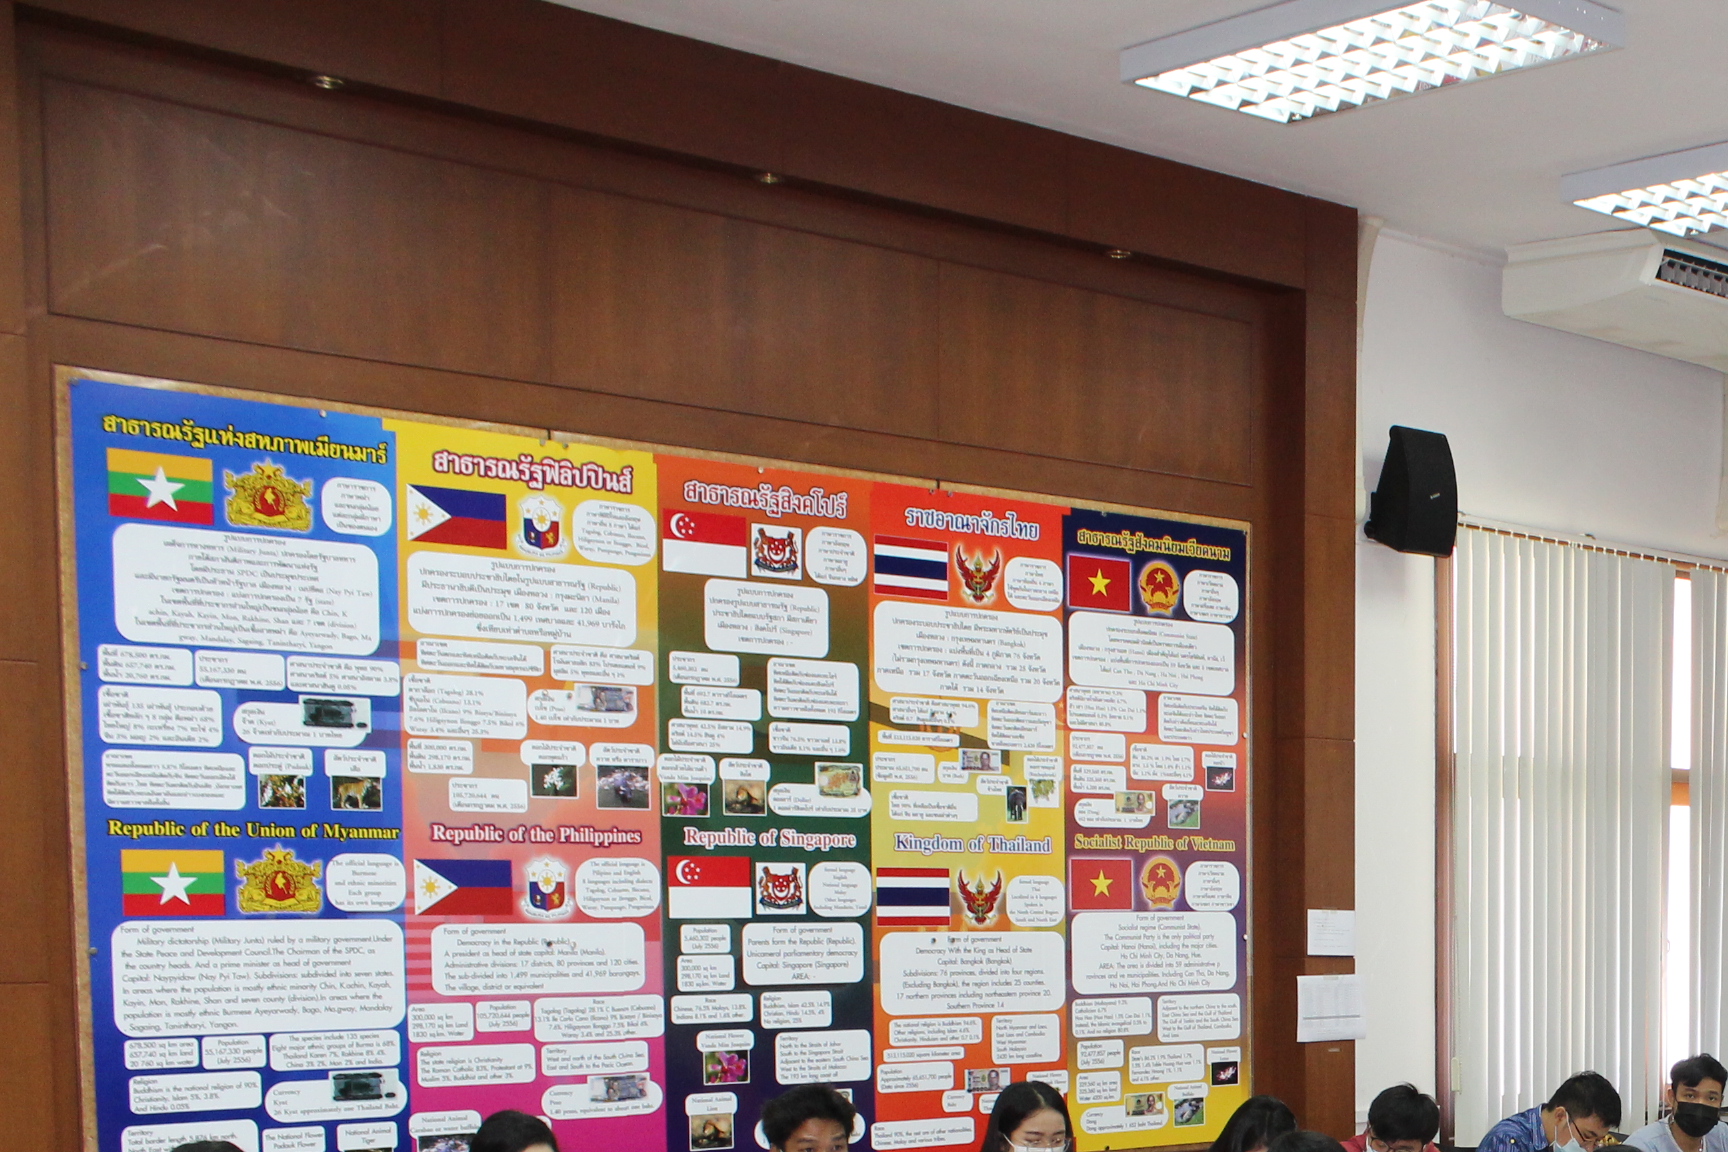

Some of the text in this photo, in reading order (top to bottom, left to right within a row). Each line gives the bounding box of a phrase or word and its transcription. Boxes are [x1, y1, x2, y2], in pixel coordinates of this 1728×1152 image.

[103, 412, 388, 466] สาธารณรัฐแห่งสหภาพเมียนมาร์
[433, 450, 634, 495] สาธารณรัฐฟิลิปปินส์
[683, 479, 848, 519] สาธารณรัฐสิงคโปร์
[905, 507, 1040, 541] ราชอาณาจักรไทย
[108, 820, 400, 841] Republic of the Union of Myanmar
[431, 823, 641, 846] Republic of the Philippines
[684, 827, 856, 850] Republic of Singapore
[1075, 834, 1235, 852] Socialist Republic of Vietnam
[894, 832, 1052, 855] Kingdom of Thailand
[120, 926, 194, 935] Form of government
[471, 928, 506, 936] government
[799, 927, 832, 935] government
[971, 936, 1002, 944] government
[1183, 933, 1201, 941] political
[457, 939, 491, 947] Democracy
[499, 938, 511, 946] the
[513, 938, 539, 946] Republic
[799, 938, 824, 946] Republic
[826, 938, 856, 946] (Republic).
[451, 949, 480, 958] president
[491, 949, 507, 957] head
[534, 949, 555, 958] capital:
[558, 948, 578, 956] Manila
[580, 948, 605, 957] (Manila).
[783, 950, 824, 958] parliamentary
[826, 950, 858, 958] democracy
[973, 947, 986, 955] King
[530, 960, 553, 968] districts,
[567, 960, 594, 968] provinces
[624, 958, 639, 966] cities.
[757, 961, 849, 970] Capital: Singapore (Singapore)
[938, 958, 958, 966] Capital:
[960, 958, 983, 966] Bangkok
[511, 971, 528, 979] 1,499
[530, 970, 569, 979] municipalities
[572, 970, 583, 978] and
[585, 970, 606, 978] 41,969
[609, 970, 640, 978] barangays.
